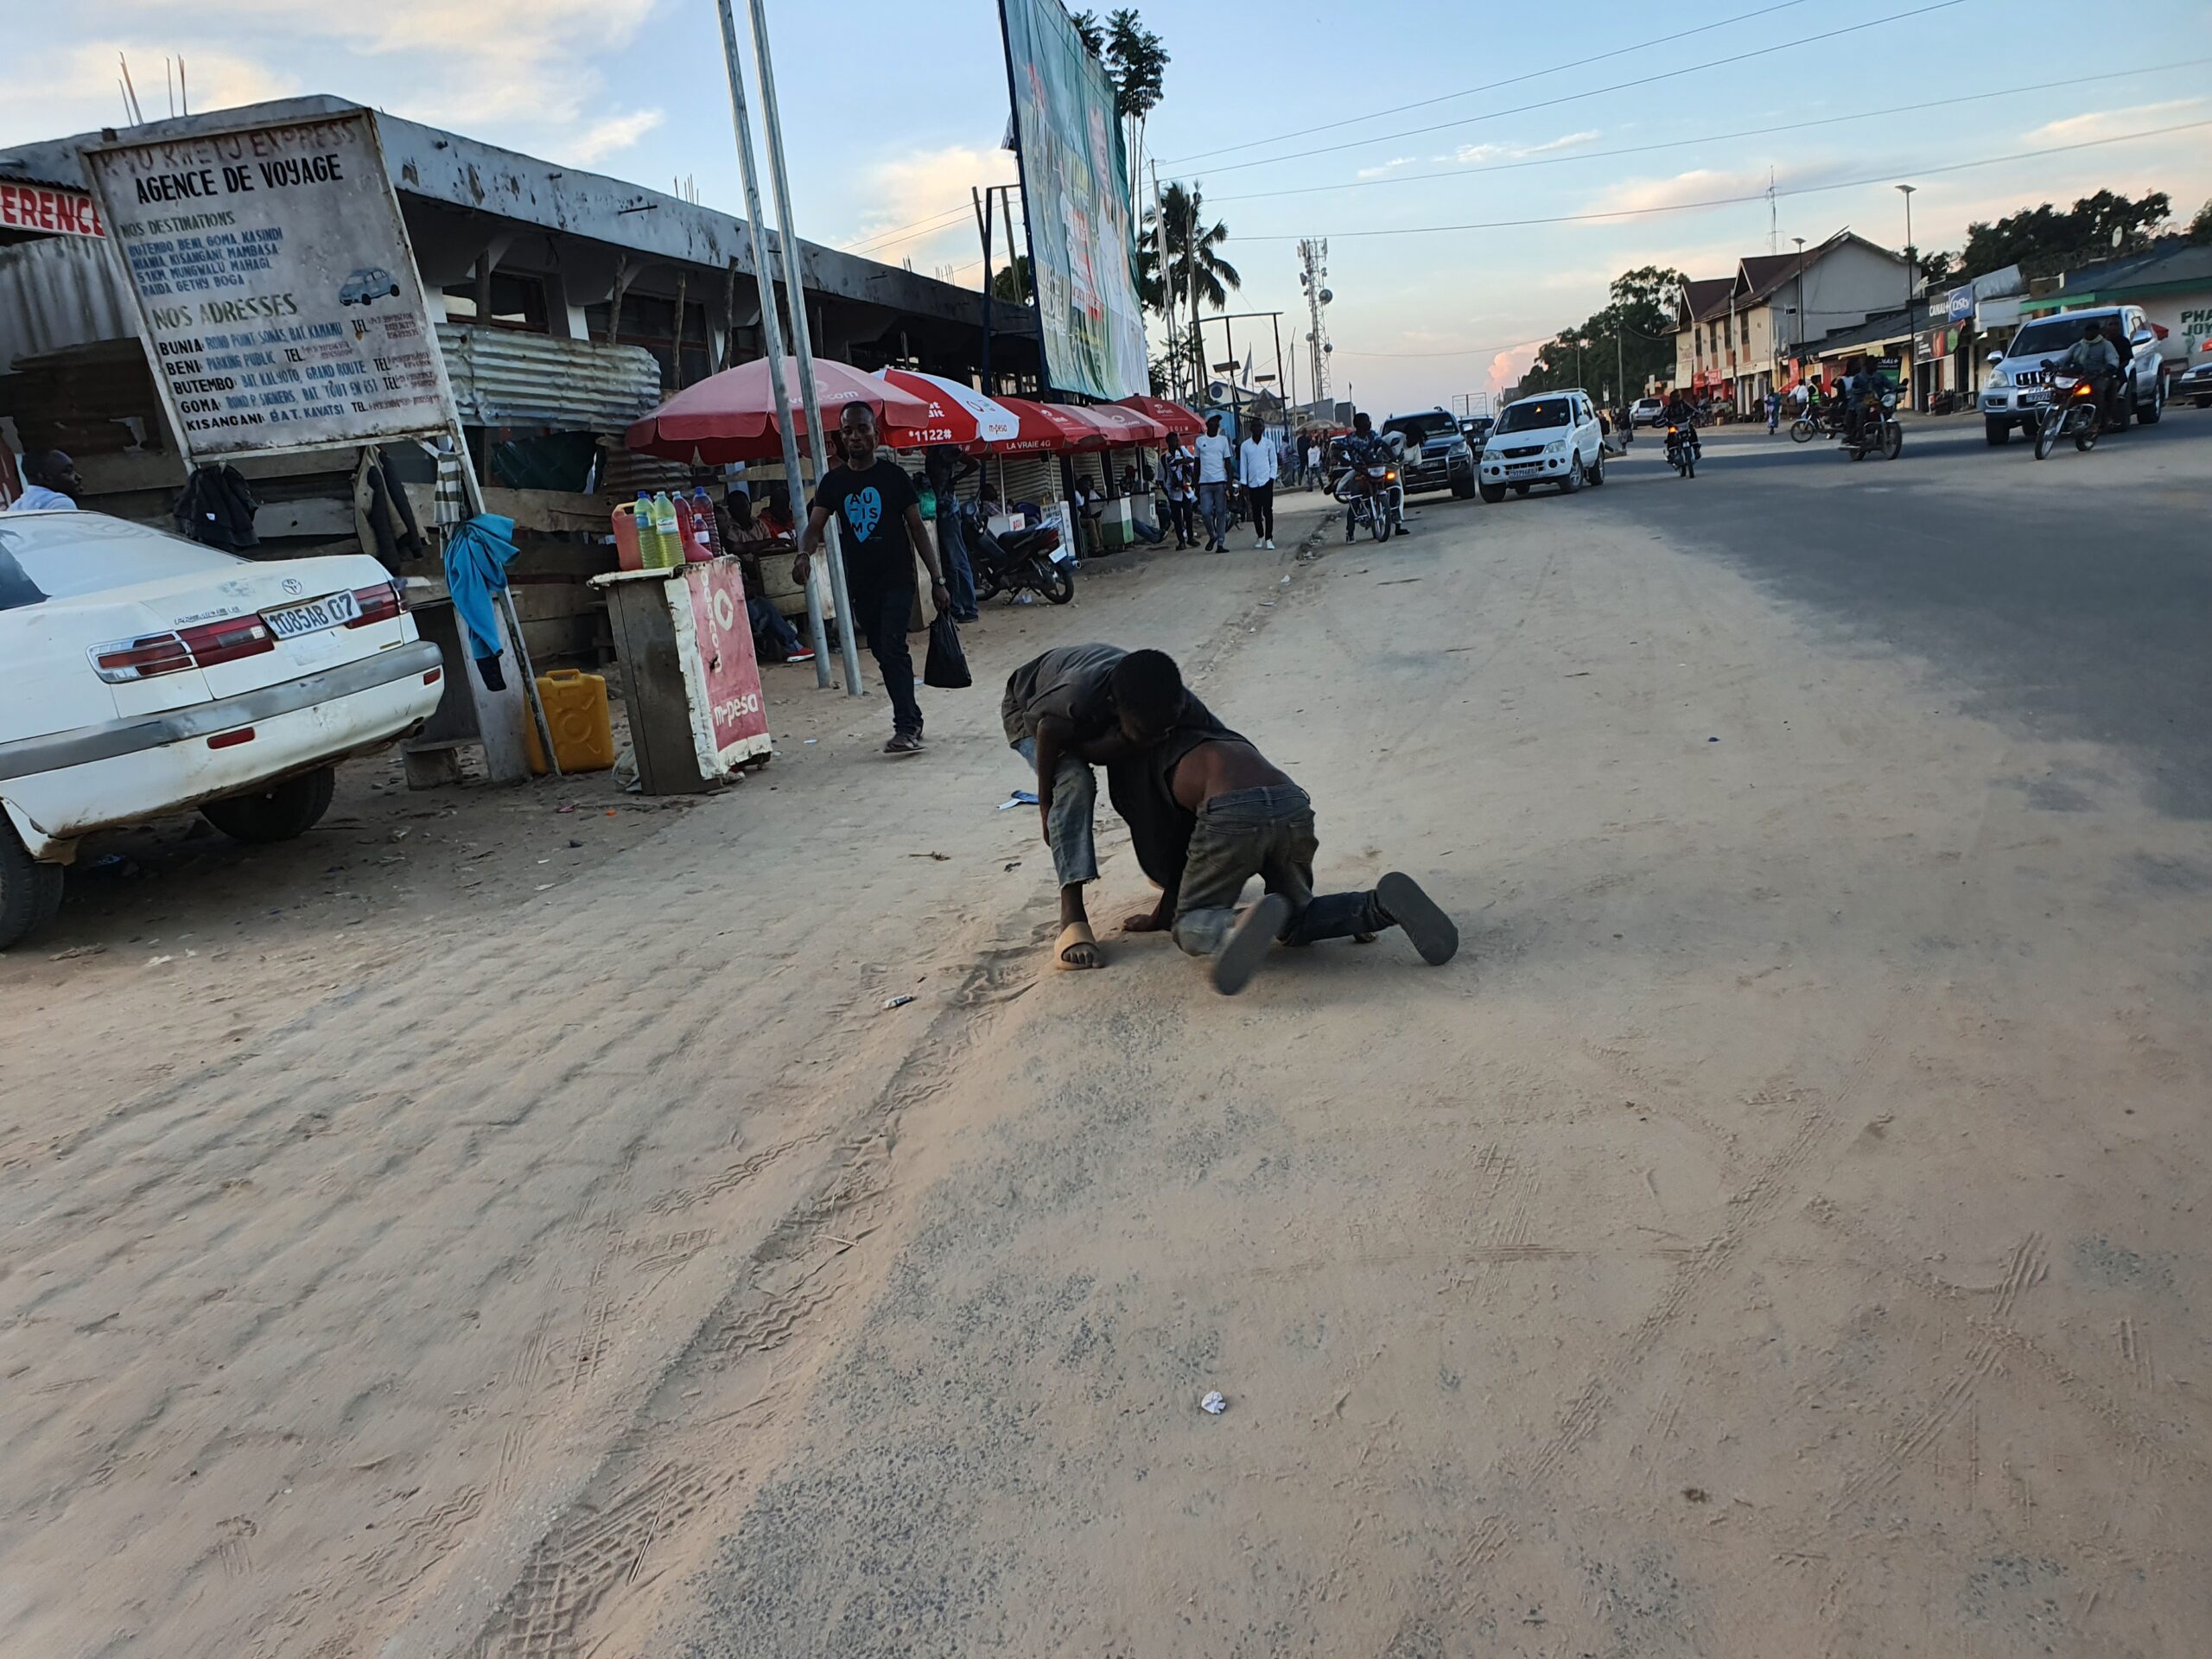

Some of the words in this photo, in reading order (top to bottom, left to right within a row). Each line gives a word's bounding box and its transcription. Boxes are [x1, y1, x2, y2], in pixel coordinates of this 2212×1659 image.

[135, 169, 218, 204] AGENCE
[222, 165, 254, 193] DE
[259, 154, 343, 188] VOYAGE
[119, 222, 145, 238] NOS
[148, 211, 236, 235] DESTINATIONS
[242, 226, 283, 244] KASINDI
[214, 274, 245, 287] BOGA
[152, 305, 193, 330] NOS
[200, 293, 298, 324] ADRESSES
[244, 351, 276, 366] PUBLIC
[306, 363, 334, 380] GRAND
[337, 360, 366, 377] ROUTE
[1020, 441, 1039, 449] VRAIE
[327, 594, 353, 620] 07
[714, 694, 759, 728] m-pesa
